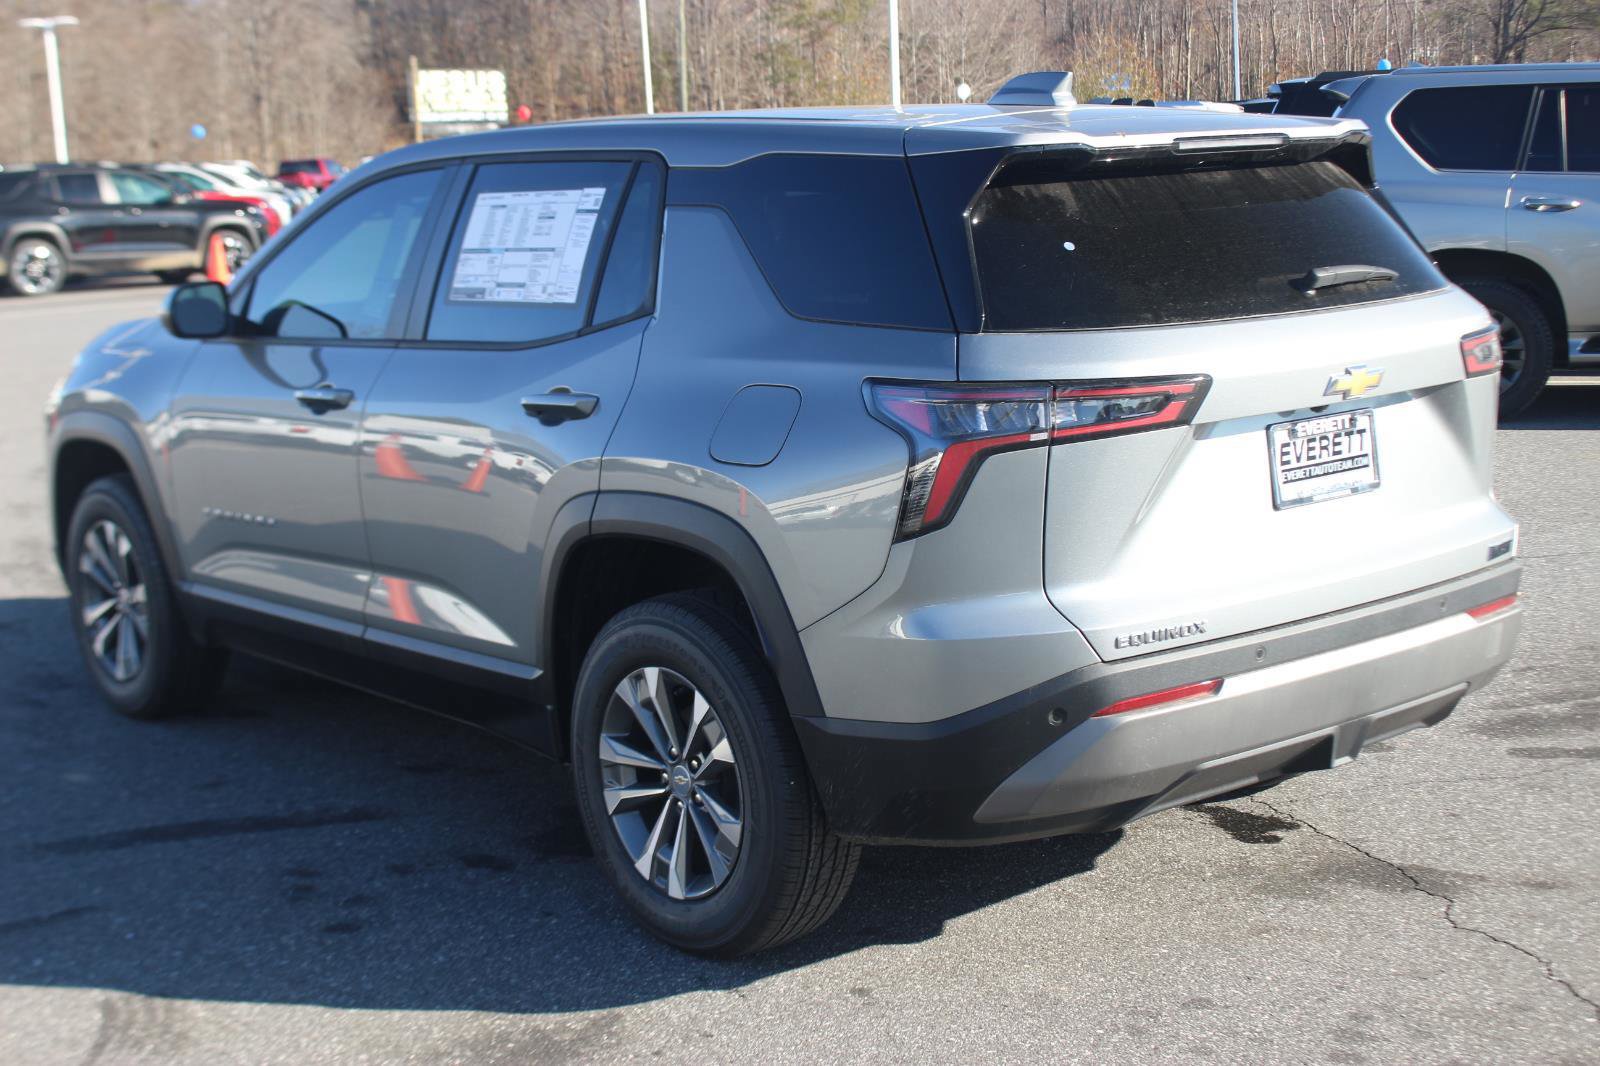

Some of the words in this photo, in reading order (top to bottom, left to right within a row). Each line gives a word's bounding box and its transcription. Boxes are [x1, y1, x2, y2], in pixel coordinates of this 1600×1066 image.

[1296, 414, 1352, 437] EVERETT
[1280, 428, 1367, 466] EVERETT
[1114, 621, 1207, 649] EQUINOX
